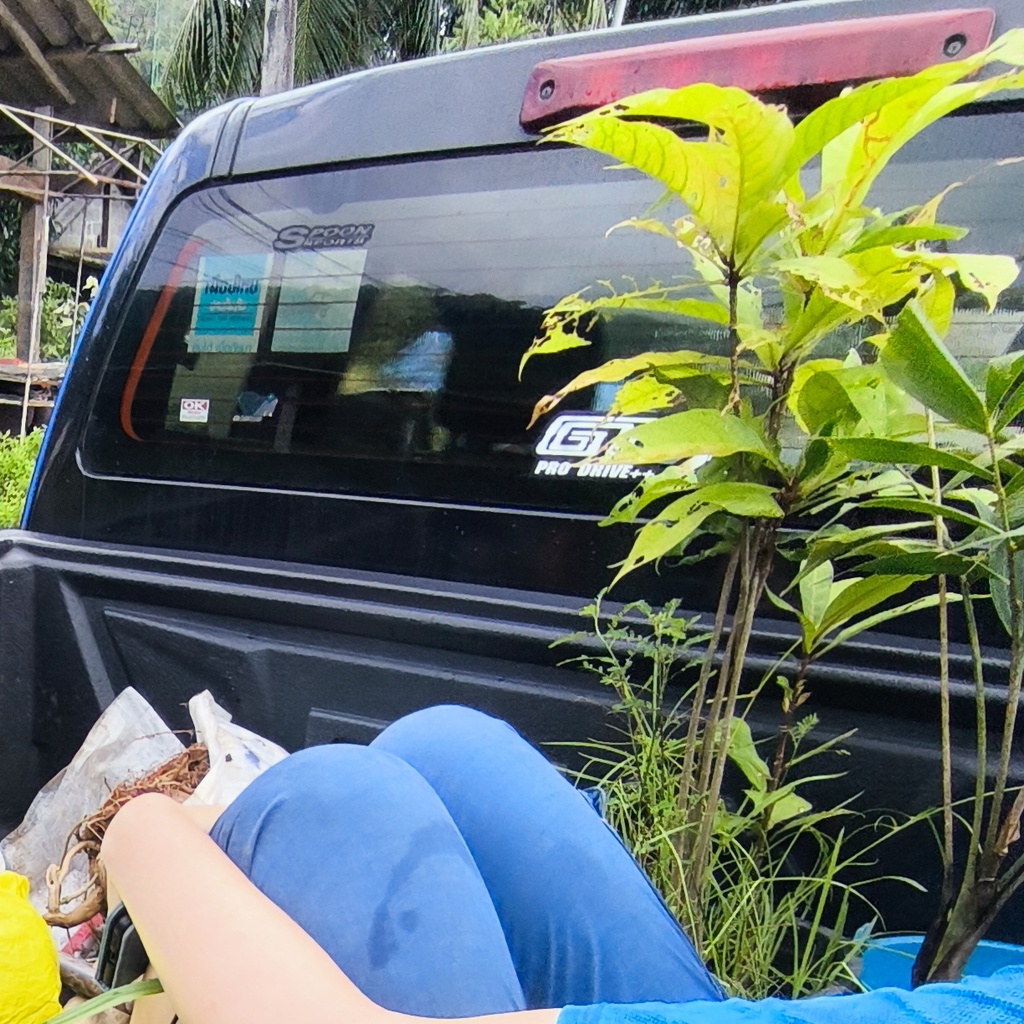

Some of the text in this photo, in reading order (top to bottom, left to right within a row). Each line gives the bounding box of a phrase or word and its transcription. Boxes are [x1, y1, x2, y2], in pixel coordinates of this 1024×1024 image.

[274, 224, 374, 251] SPOON
[183, 400, 208, 411] OK
[535, 460, 571, 475] PRO
